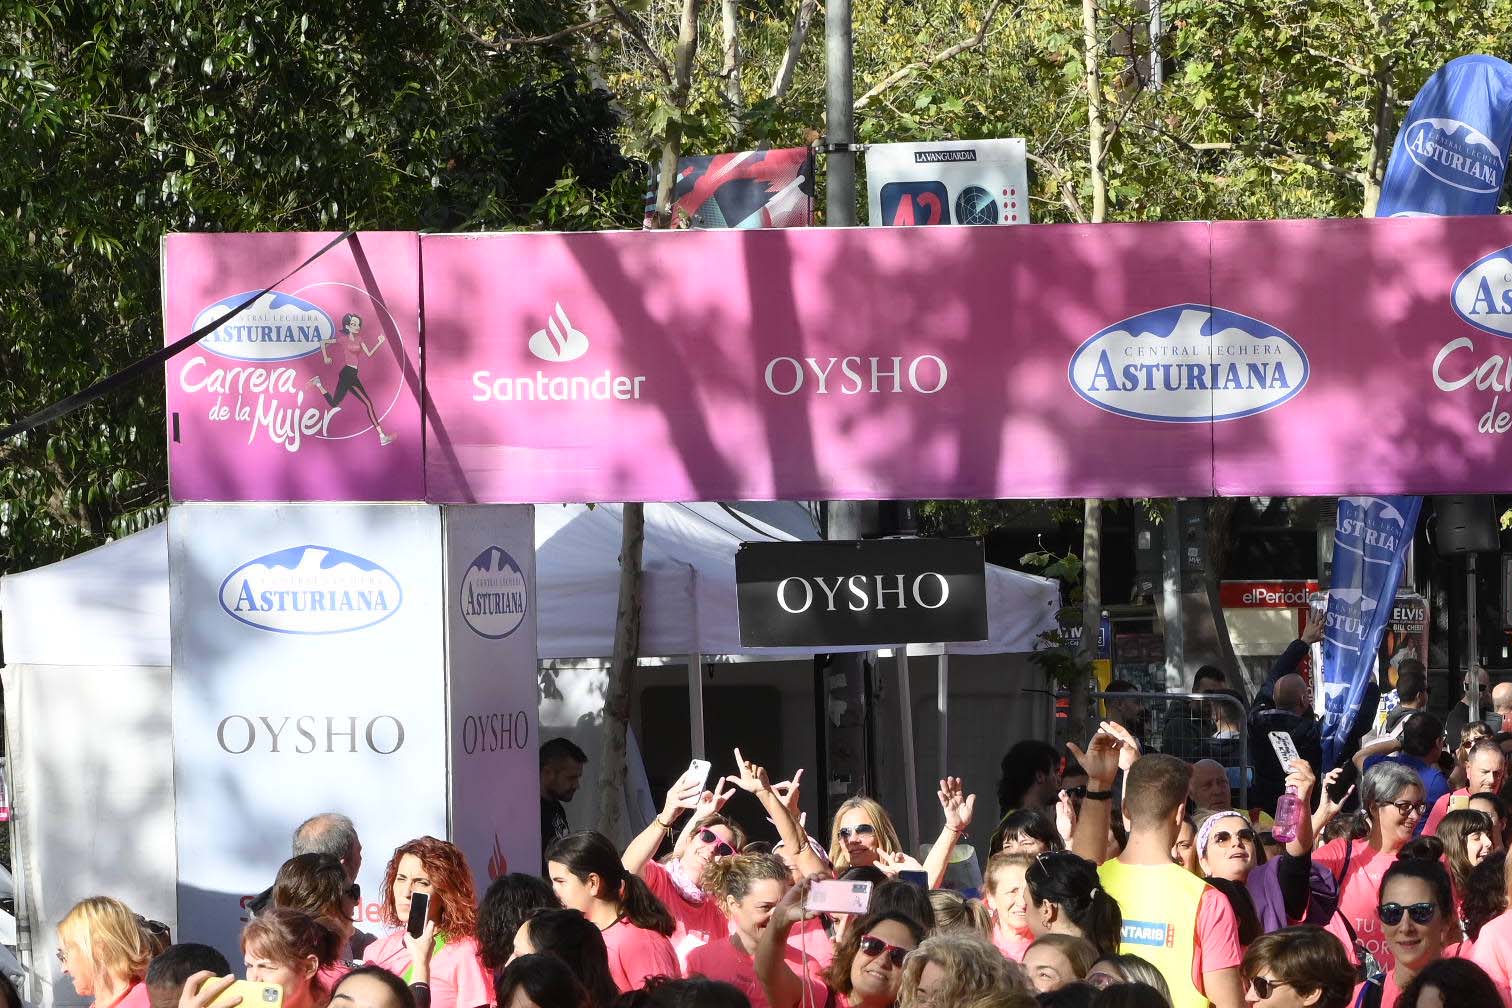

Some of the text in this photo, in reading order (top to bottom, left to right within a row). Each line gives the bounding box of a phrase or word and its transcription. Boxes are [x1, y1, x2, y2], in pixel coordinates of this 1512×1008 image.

[1411, 128, 1498, 188] ASTURIANA
[205, 315, 322, 343] ASTURIANA
[1124, 343, 1283, 356] CENTRAL LECHERA
[179, 356, 298, 394] Carrera
[472, 368, 648, 401] Santander
[764, 353, 950, 396] OYSHO
[1087, 348, 1290, 393] ASTURIANA
[208, 391, 342, 452] de la Mujer
[1478, 394, 1512, 436] de
[234, 578, 390, 613] ASTURIANA
[465, 581, 524, 617] ASTURIANA
[776, 571, 950, 614] OYSHO
[1393, 607, 1425, 620] ELVIS
[216, 714, 406, 755] OYSHO
[462, 709, 530, 755] OYSHO
[1355, 918, 1375, 933] TU
